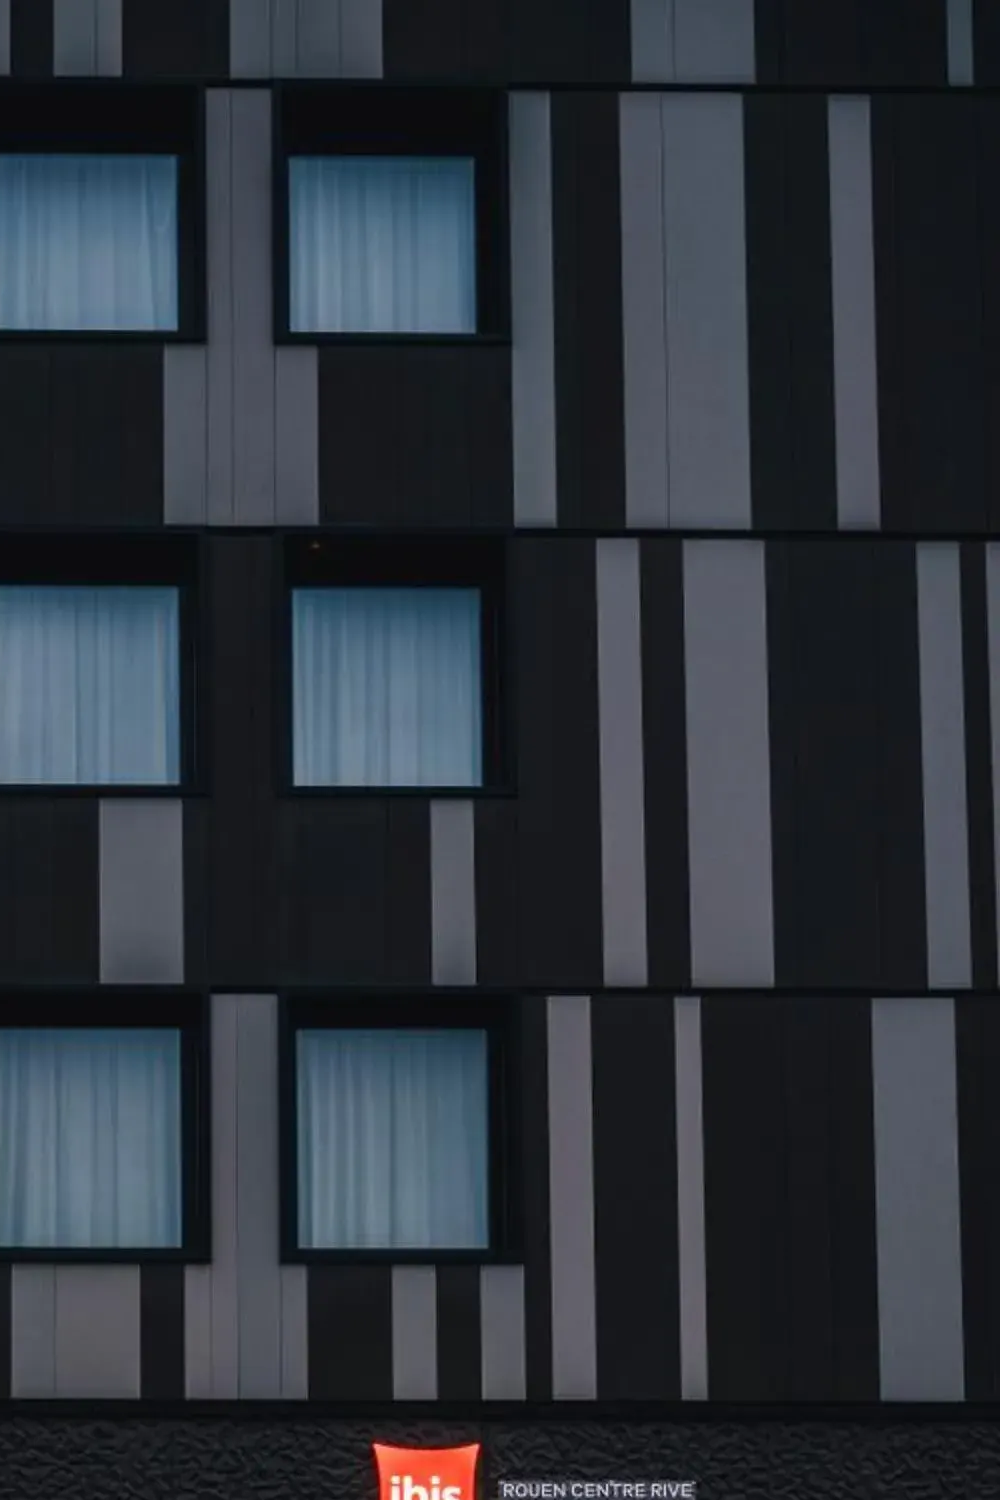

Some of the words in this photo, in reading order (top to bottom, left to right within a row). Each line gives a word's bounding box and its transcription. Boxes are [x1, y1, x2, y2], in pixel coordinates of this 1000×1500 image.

[503, 1483, 566, 1498] ROUEN
[571, 1483, 647, 1498] CENTRE
[651, 1483, 693, 1498] RIVE
